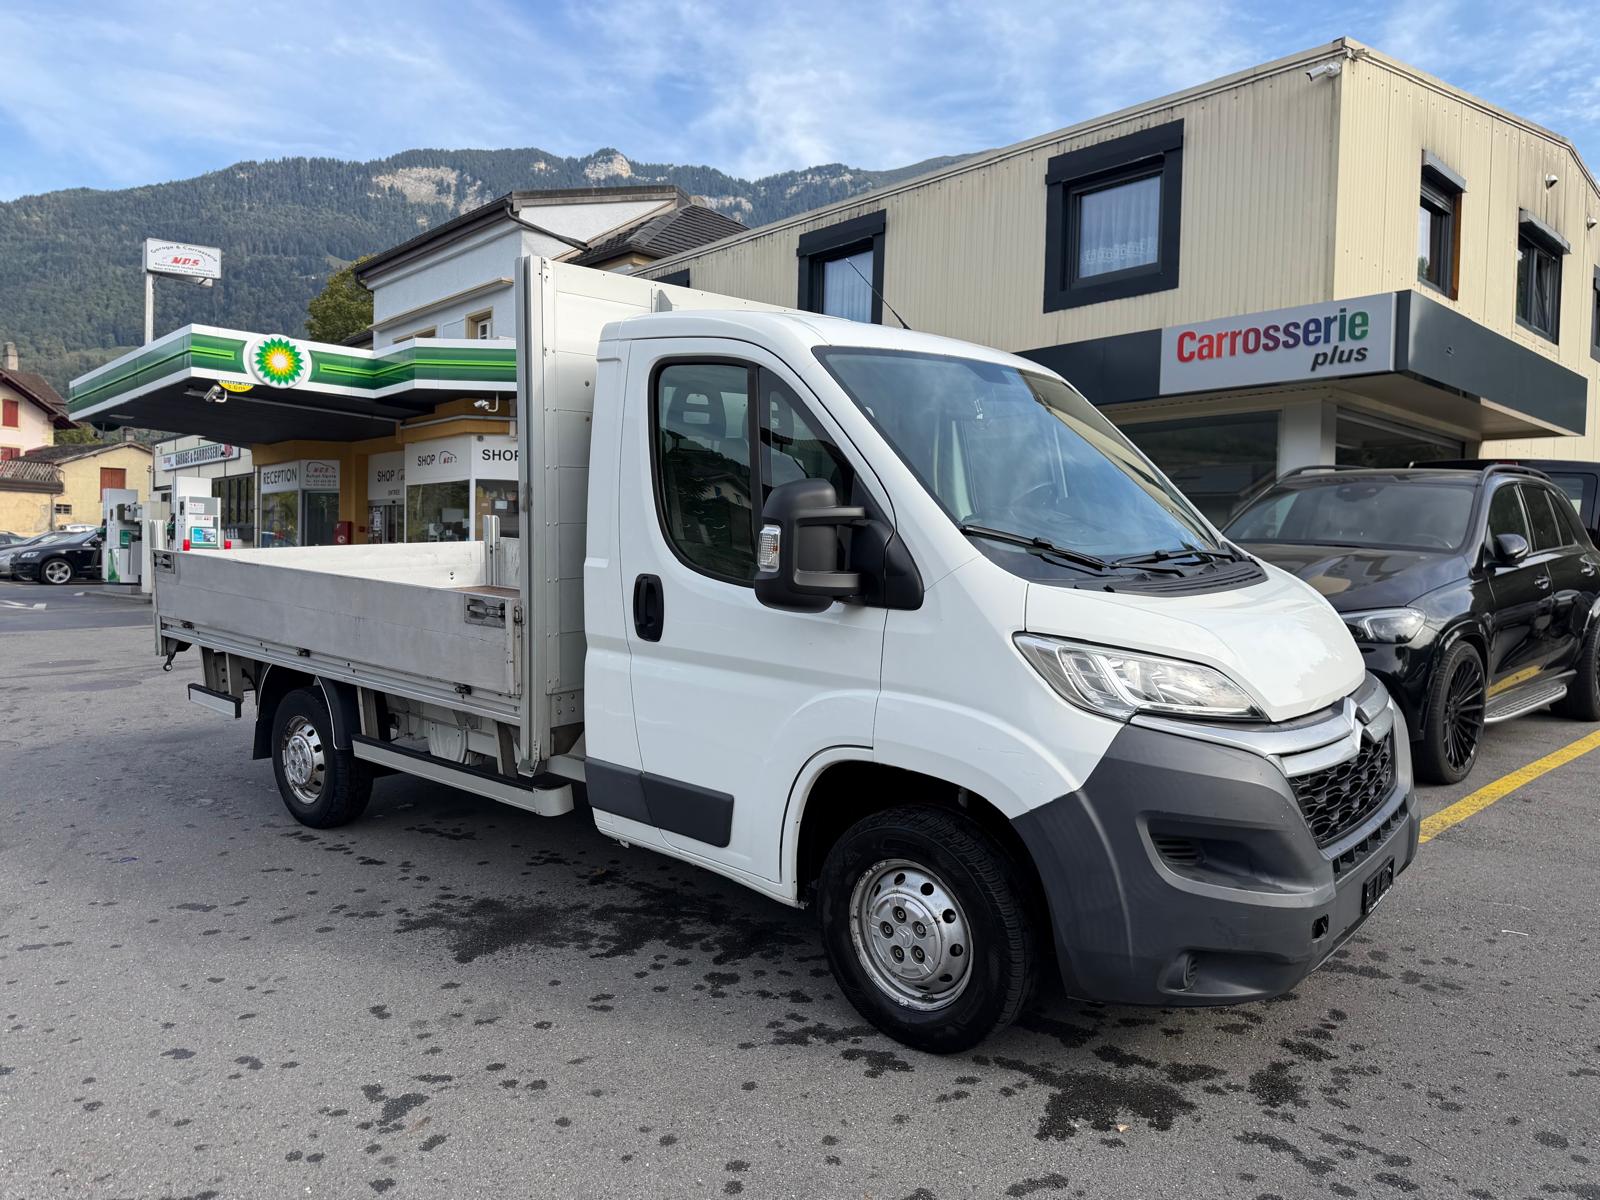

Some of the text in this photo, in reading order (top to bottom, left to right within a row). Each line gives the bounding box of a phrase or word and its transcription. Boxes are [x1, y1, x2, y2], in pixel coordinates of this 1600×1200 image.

[1176, 308, 1369, 364] Carrosserie
[1310, 345, 1369, 372] plus
[175, 451, 190, 466] GARAGE
[193, 444, 223, 462] CARROSSERIE
[417, 454, 436, 467] SHOP
[263, 467, 297, 485] RECEPTION
[377, 470, 395, 482] SHOP
